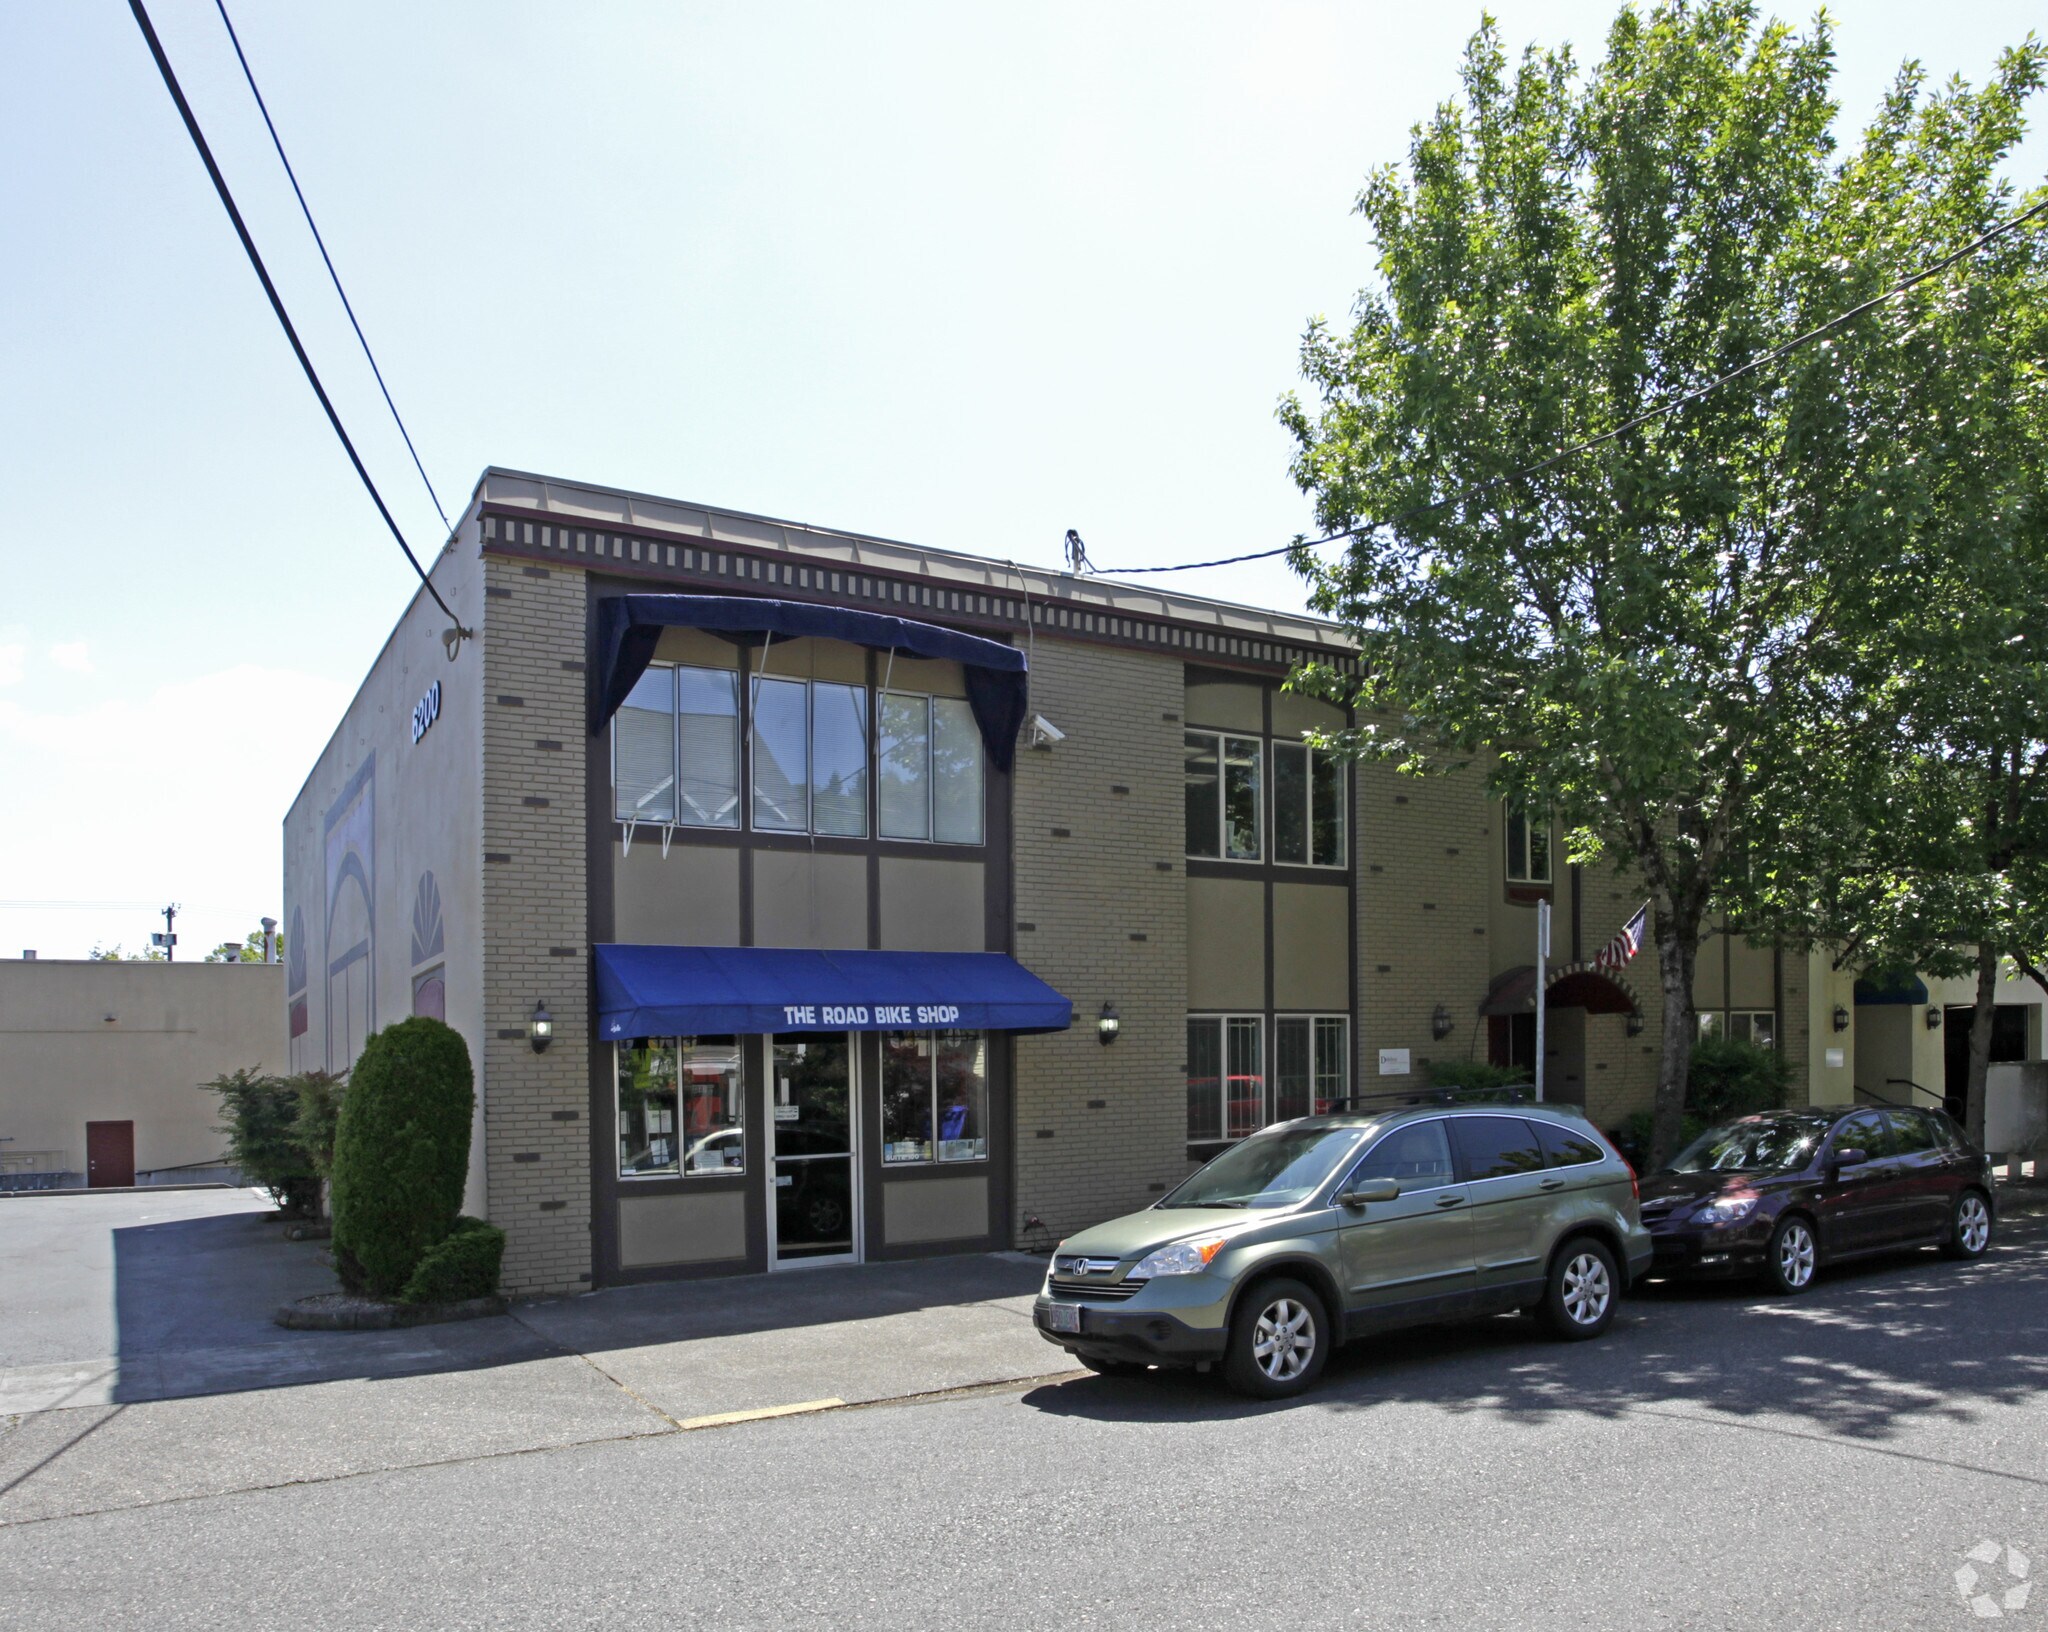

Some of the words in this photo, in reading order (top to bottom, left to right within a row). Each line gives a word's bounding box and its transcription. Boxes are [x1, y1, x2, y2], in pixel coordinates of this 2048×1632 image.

[412, 680, 441, 744] 6200
[784, 1006, 816, 1024] THE
[822, 1006, 868, 1024] ROAD
[875, 1006, 911, 1024] BIKE
[917, 1005, 959, 1023] SHOP
